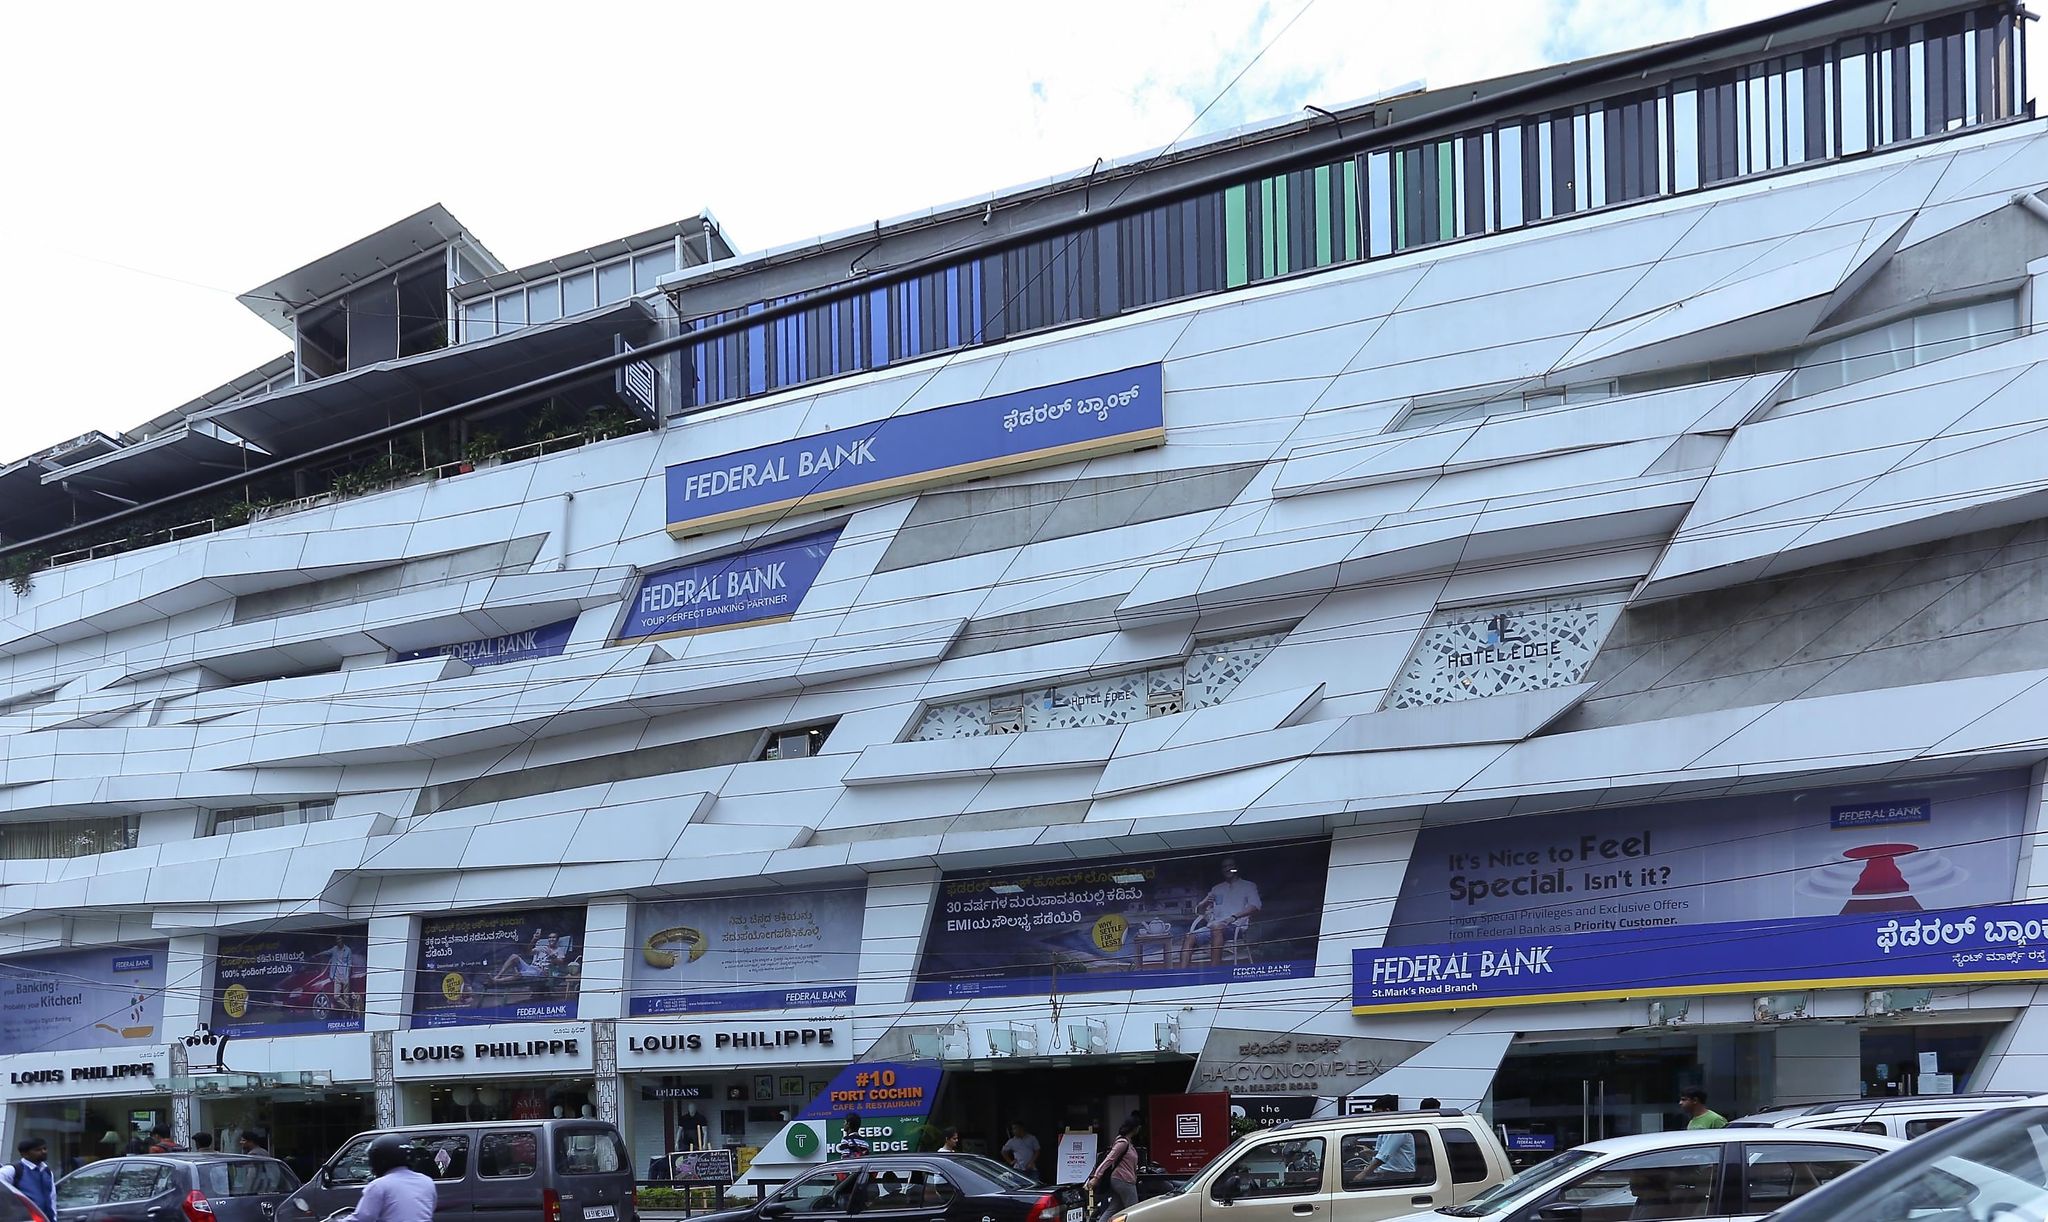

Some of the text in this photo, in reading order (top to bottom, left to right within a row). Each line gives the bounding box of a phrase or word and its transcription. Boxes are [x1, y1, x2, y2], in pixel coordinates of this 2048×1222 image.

[1003, 385, 1140, 432] ಫೆಡರಲ್ ಬ್ಯಾಂಕ್
[685, 436, 876, 502] FEDERAL BANK
[640, 561, 787, 613] FEDERAL BANK
[641, 594, 788, 627] YOUR PERFECT BANKING PARTNER
[498, 631, 538, 656] BANK
[1449, 641, 1561, 668] HOTEL EDGE
[1071, 690, 1131, 706] HOTEL EDGE
[1839, 809, 1885, 821] FEDERAL
[1889, 807, 1921, 817] BANK
[1450, 830, 1650, 871] It's Nice to Feel
[1450, 866, 1671, 905] Special. Isn't it?
[946, 888, 1143, 913] 30 ವರ್ಷಗಳ ಮರುಪಾವತಿಯಲ್ಲಿ ಕಡಿಮೆ
[1449, 898, 1689, 926] Enjoy Special Privileges and Exclusive Offers
[991, 914, 1031, 931] ಸೌಲಭ್ಯ
[1033, 911, 1082, 925] ಪಡೆಯಿರಿ
[1098, 920, 1113, 929] WHY
[1449, 929, 1473, 940] from
[1476, 925, 1516, 937] Federal
[1519, 923, 1546, 935] Bank
[1550, 925, 1561, 933] as
[1574, 919, 1616, 932] Priority
[1619, 916, 1678, 929] Customer.
[1100, 925, 1121, 934] SETTLE
[1877, 915, 2048, 953] ಫೆಡರಲ್ ಬ್ಯಾಂ
[1102, 938, 1120, 948] LESS?
[2028, 950, 2046, 962] ರಸ್ತೆ
[1233, 964, 1291, 975] FEDERAL BANK
[1372, 946, 1553, 985] FEDERAL BANK
[221, 970, 239, 979] 100%
[16, 980, 59, 995] Banking?
[1372, 983, 1478, 998] St.Mark's Road Branch
[41, 993, 82, 1008] Kitchen!
[786, 990, 846, 1002] FEDERAL BANK
[517, 1006, 566, 1016] FEDERAL BANK
[629, 1027, 834, 1053] LOUIS PHILIPPE
[400, 1038, 578, 1062] LOUIS PHILIPPE
[11, 1062, 154, 1085] LOUIS PHILIPPE
[855, 1070, 896, 1087] #10
[1200, 1058, 1383, 1083] HALCYON COMPLEX
[830, 1087, 923, 1102] FORT COCHIN
[1249, 1083, 1287, 1092] MARKS
[1289, 1082, 1318, 1090] ROAD
[517, 1099, 540, 1108] SALE
[832, 1103, 854, 1111] CAFE
[865, 1100, 922, 1109] RESTAURANT
[1260, 1104, 1280, 1113] the
[840, 1126, 892, 1137] TEEBO
[872, 1140, 909, 1152] EDGE
